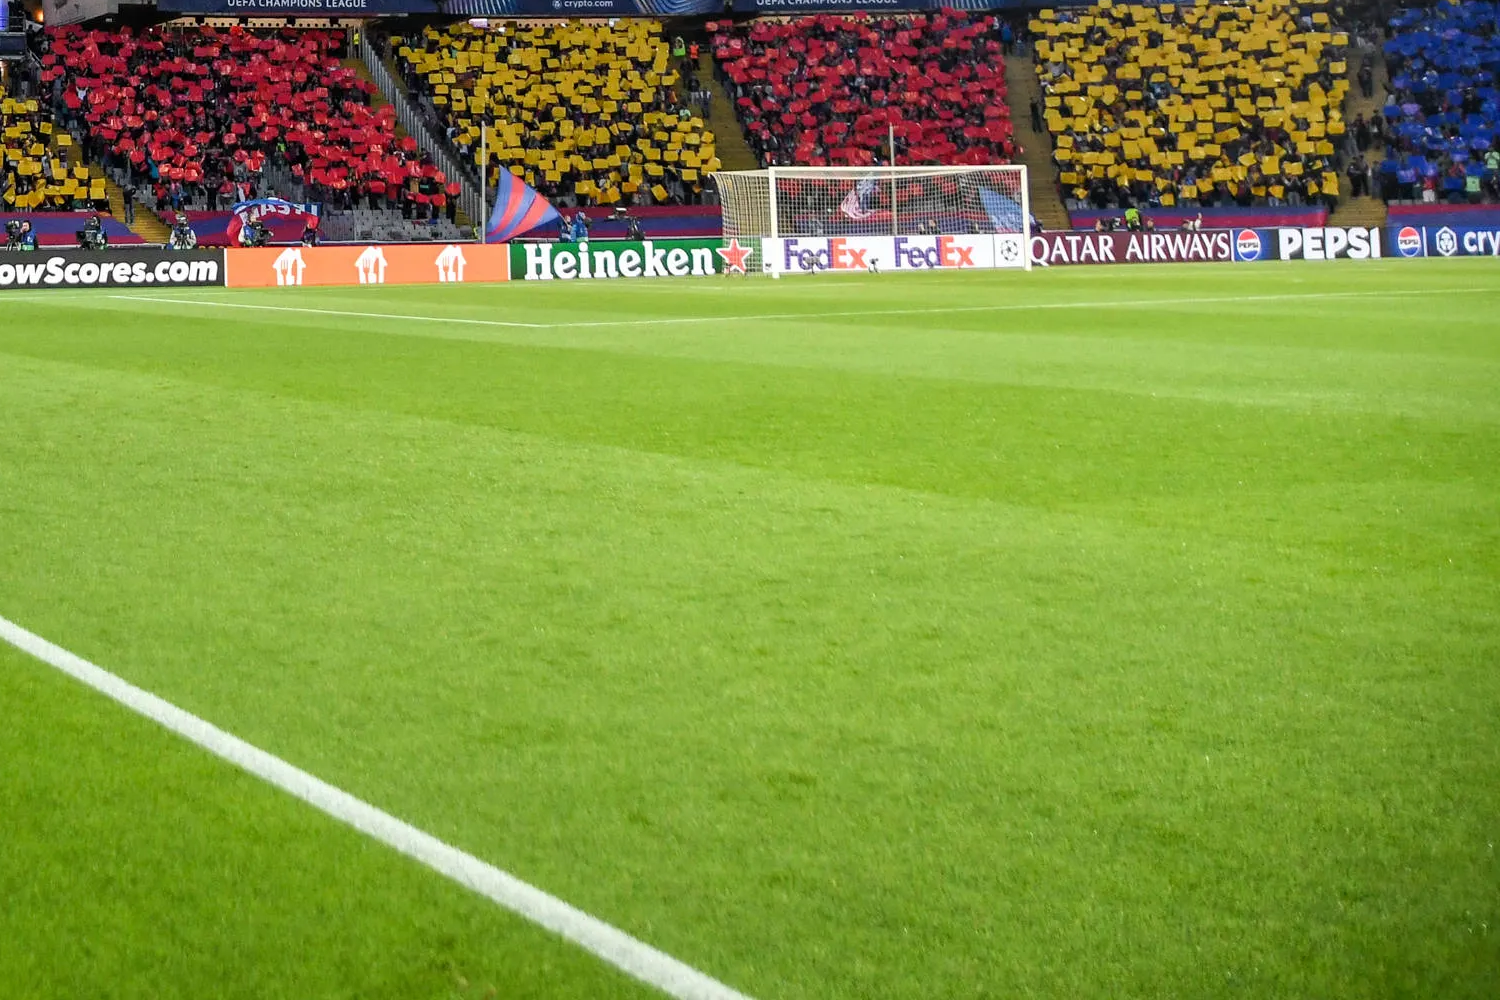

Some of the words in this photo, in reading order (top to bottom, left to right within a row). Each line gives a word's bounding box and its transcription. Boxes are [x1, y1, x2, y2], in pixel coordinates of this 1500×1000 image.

[564, 0, 613, 8] crypto.com
[783, 237, 868, 270] FedEx
[894, 236, 975, 268] FedEx
[1030, 235, 1116, 267] QATAR
[1125, 232, 1231, 262] AIRWAYS
[1238, 241, 1259, 249] PEPSI
[1278, 227, 1381, 260] PEPSI
[524, 241, 716, 280] Heineken
